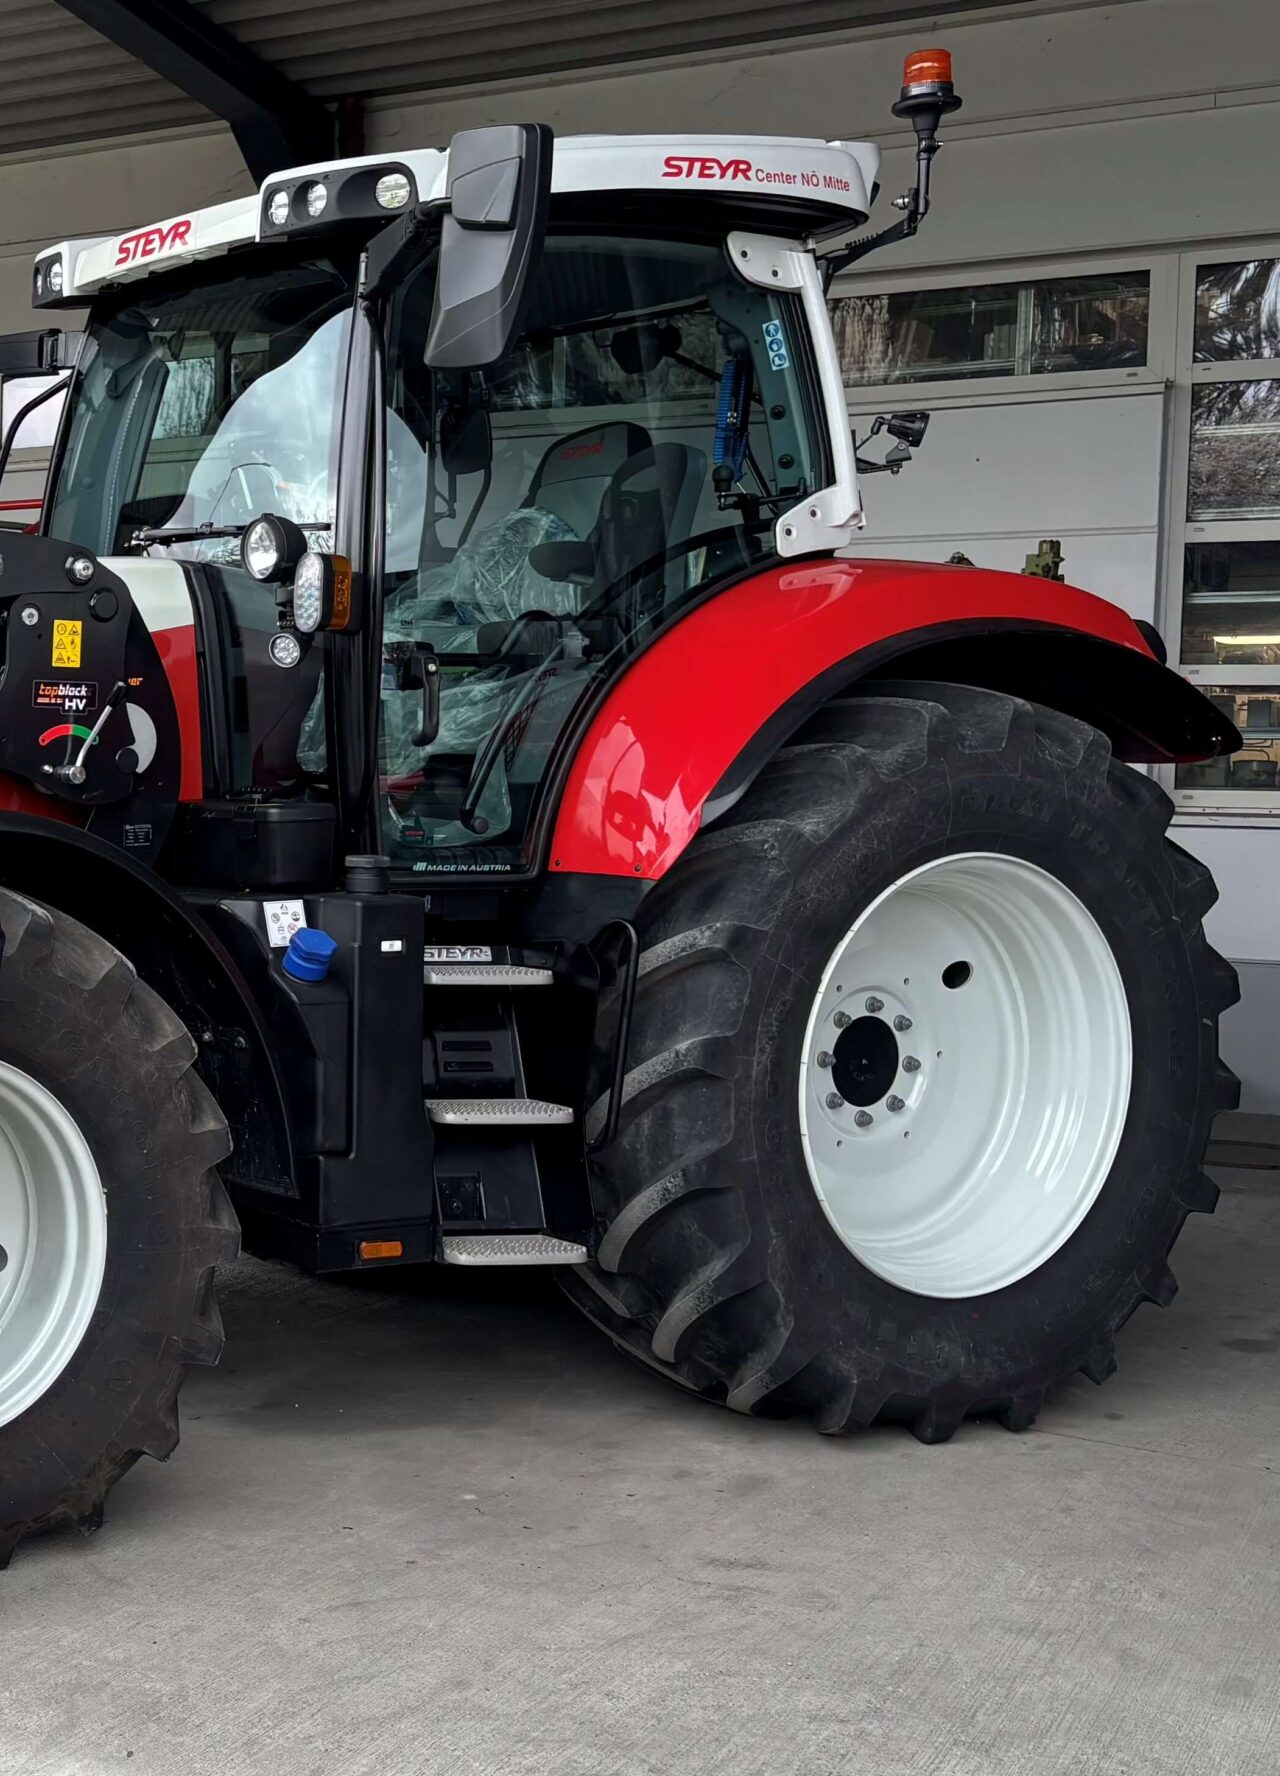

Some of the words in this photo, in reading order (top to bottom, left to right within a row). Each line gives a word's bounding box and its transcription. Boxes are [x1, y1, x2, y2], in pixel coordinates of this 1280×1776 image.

[661, 156, 753, 182] STEYR
[755, 168, 797, 185] Center
[801, 170, 820, 188] NÖ
[823, 176, 851, 193] Mitte
[115, 219, 192, 266] STEYR
[65, 697, 87, 712] HV
[427, 864, 457, 872] MADE
[458, 864, 469, 872] IN
[469, 864, 511, 872] AUSTRIA
[424, 947, 483, 959] STEYR
